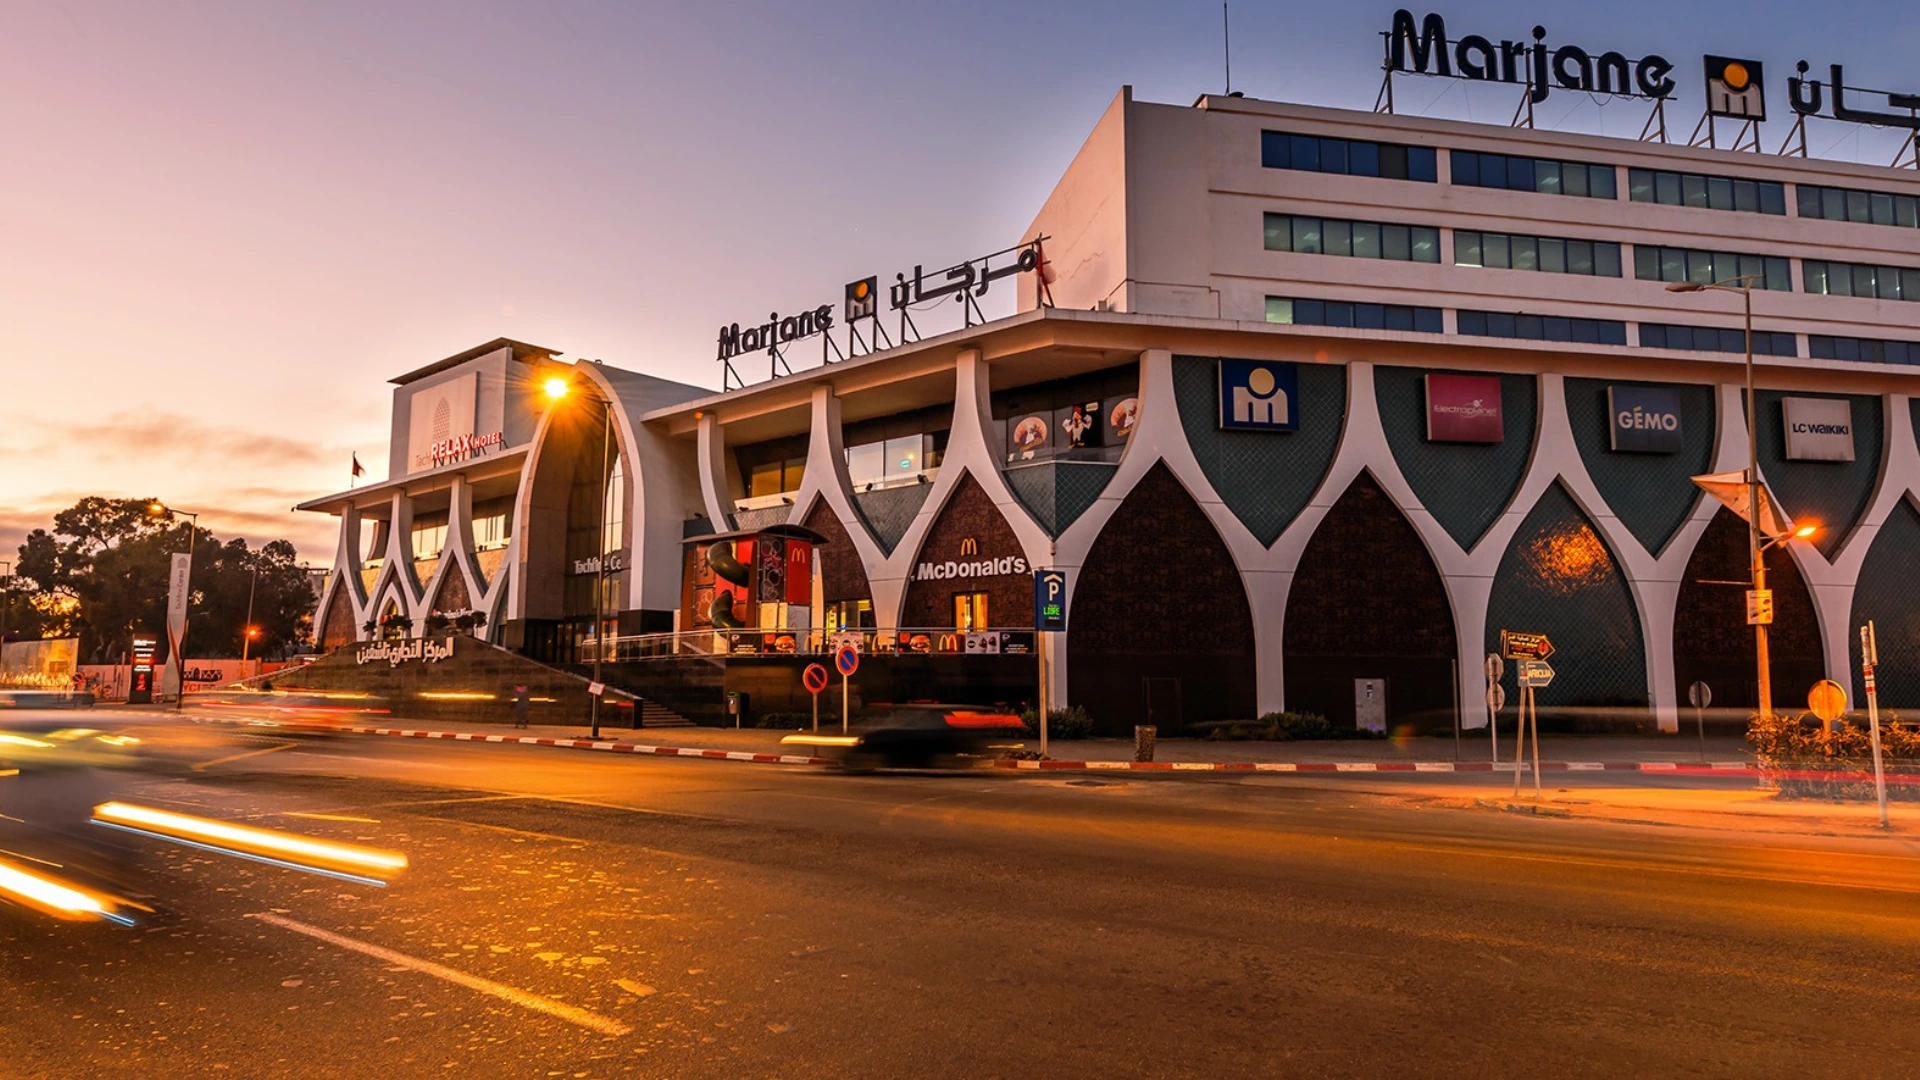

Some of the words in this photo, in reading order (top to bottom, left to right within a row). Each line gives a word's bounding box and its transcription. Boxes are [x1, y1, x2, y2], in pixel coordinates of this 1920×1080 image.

[1392, 9, 1675, 103] Marjane
[891, 249, 1038, 309] مرجان
[717, 304, 834, 361] Marjane
[1618, 406, 1678, 431] GÉMO
[1792, 423, 1806, 433] LC
[431, 433, 472, 461] RELAX
[474, 432, 502, 448] HOTEL
[917, 556, 1026, 580] McDonald's
[1049, 582, 1060, 601] P
